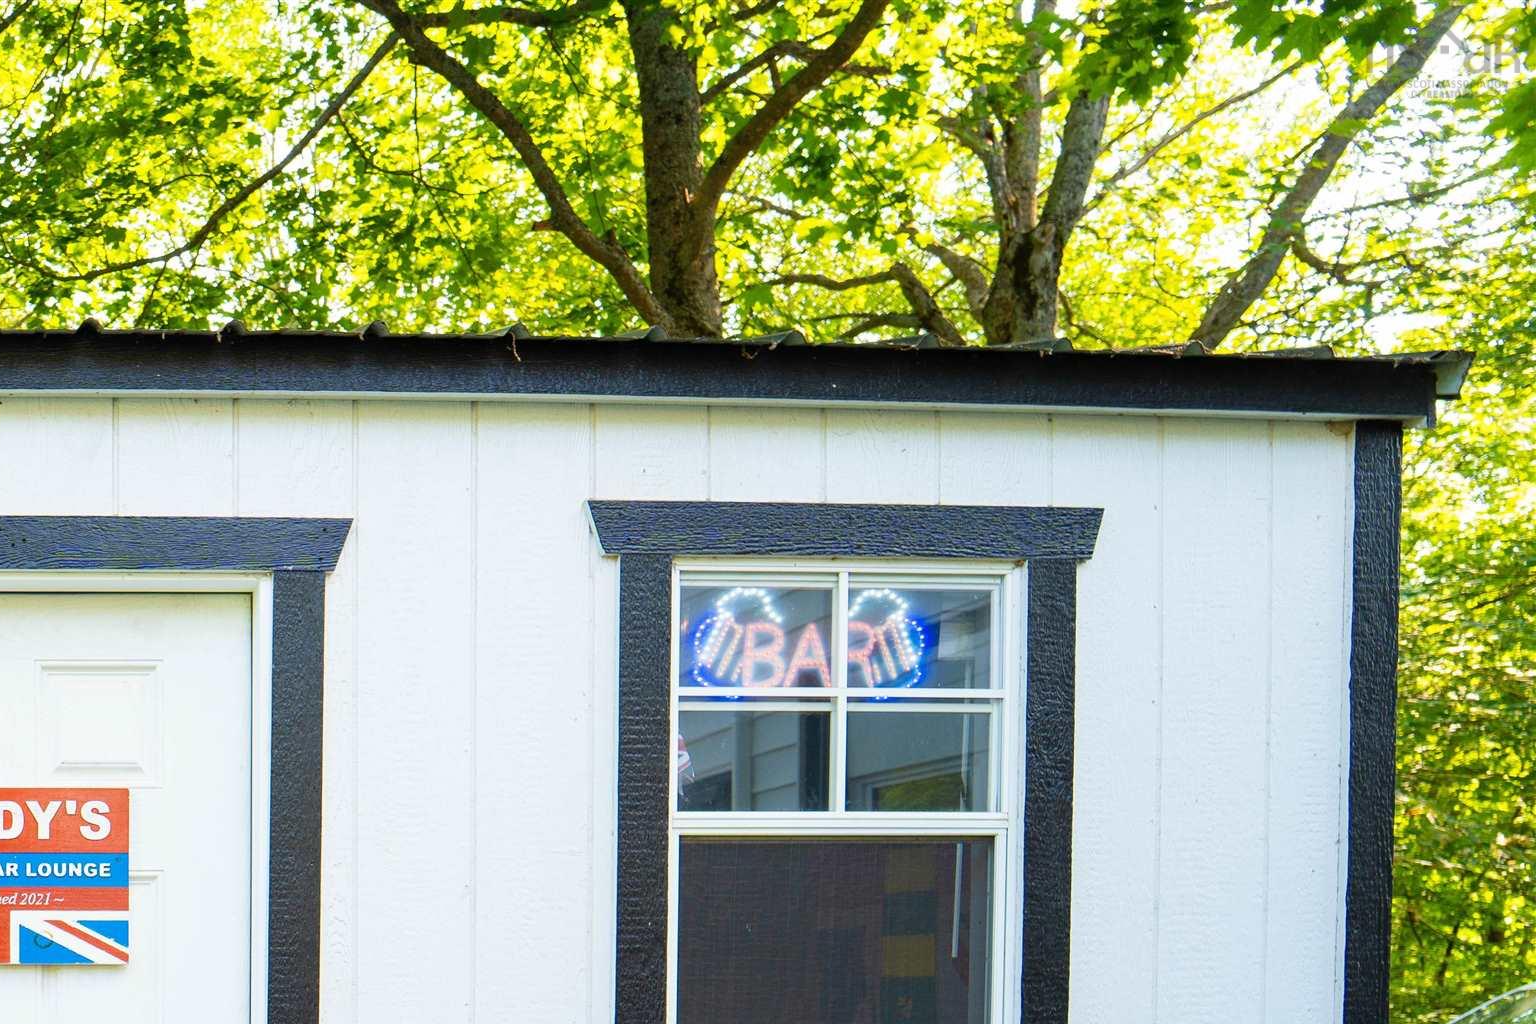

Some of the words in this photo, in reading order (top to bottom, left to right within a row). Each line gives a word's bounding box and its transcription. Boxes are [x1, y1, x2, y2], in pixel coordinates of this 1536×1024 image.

[741, 621, 876, 688] BAR
[25, 862, 112, 877] LOUNGE
[19, 892, 51, 906] 2021
